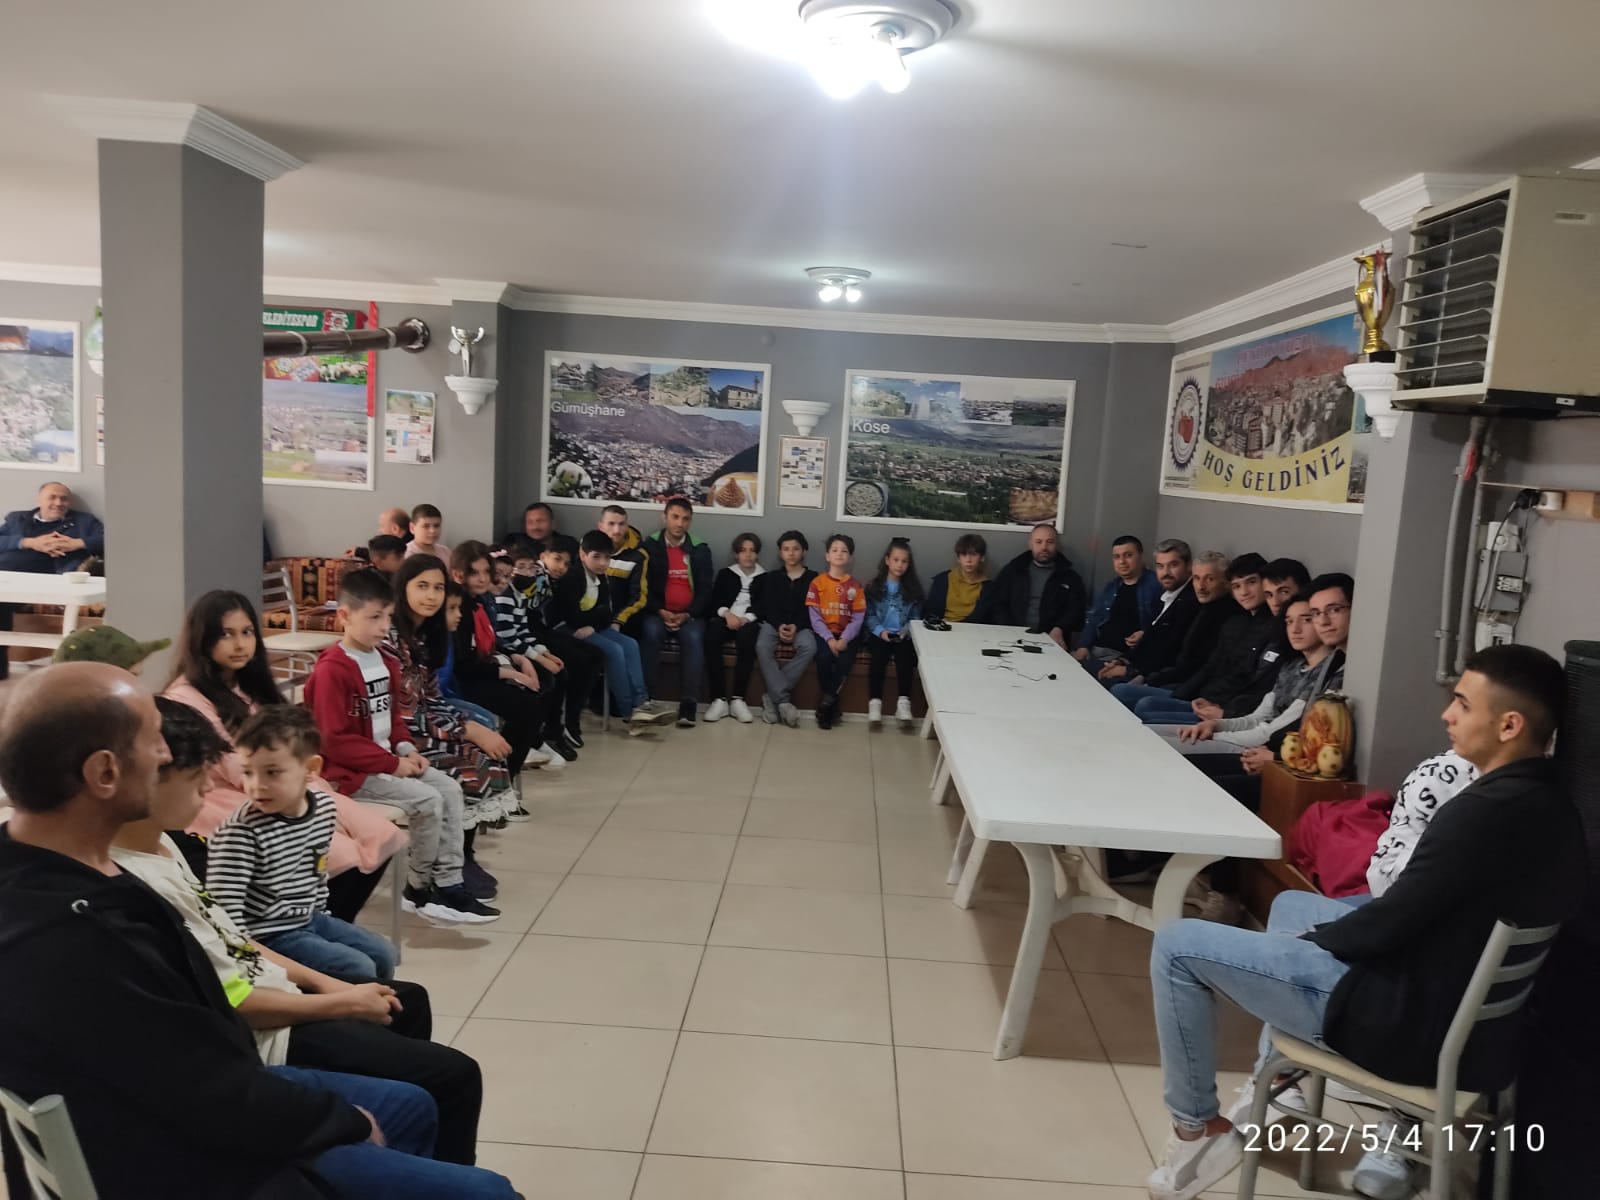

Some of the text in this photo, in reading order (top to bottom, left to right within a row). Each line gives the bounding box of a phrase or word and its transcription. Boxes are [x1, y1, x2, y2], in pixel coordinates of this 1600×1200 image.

[551, 401, 626, 417] Gümüşhane
[852, 418, 890, 434] Köse
[1203, 446, 1346, 492] HOŞ GELDİNİZ
